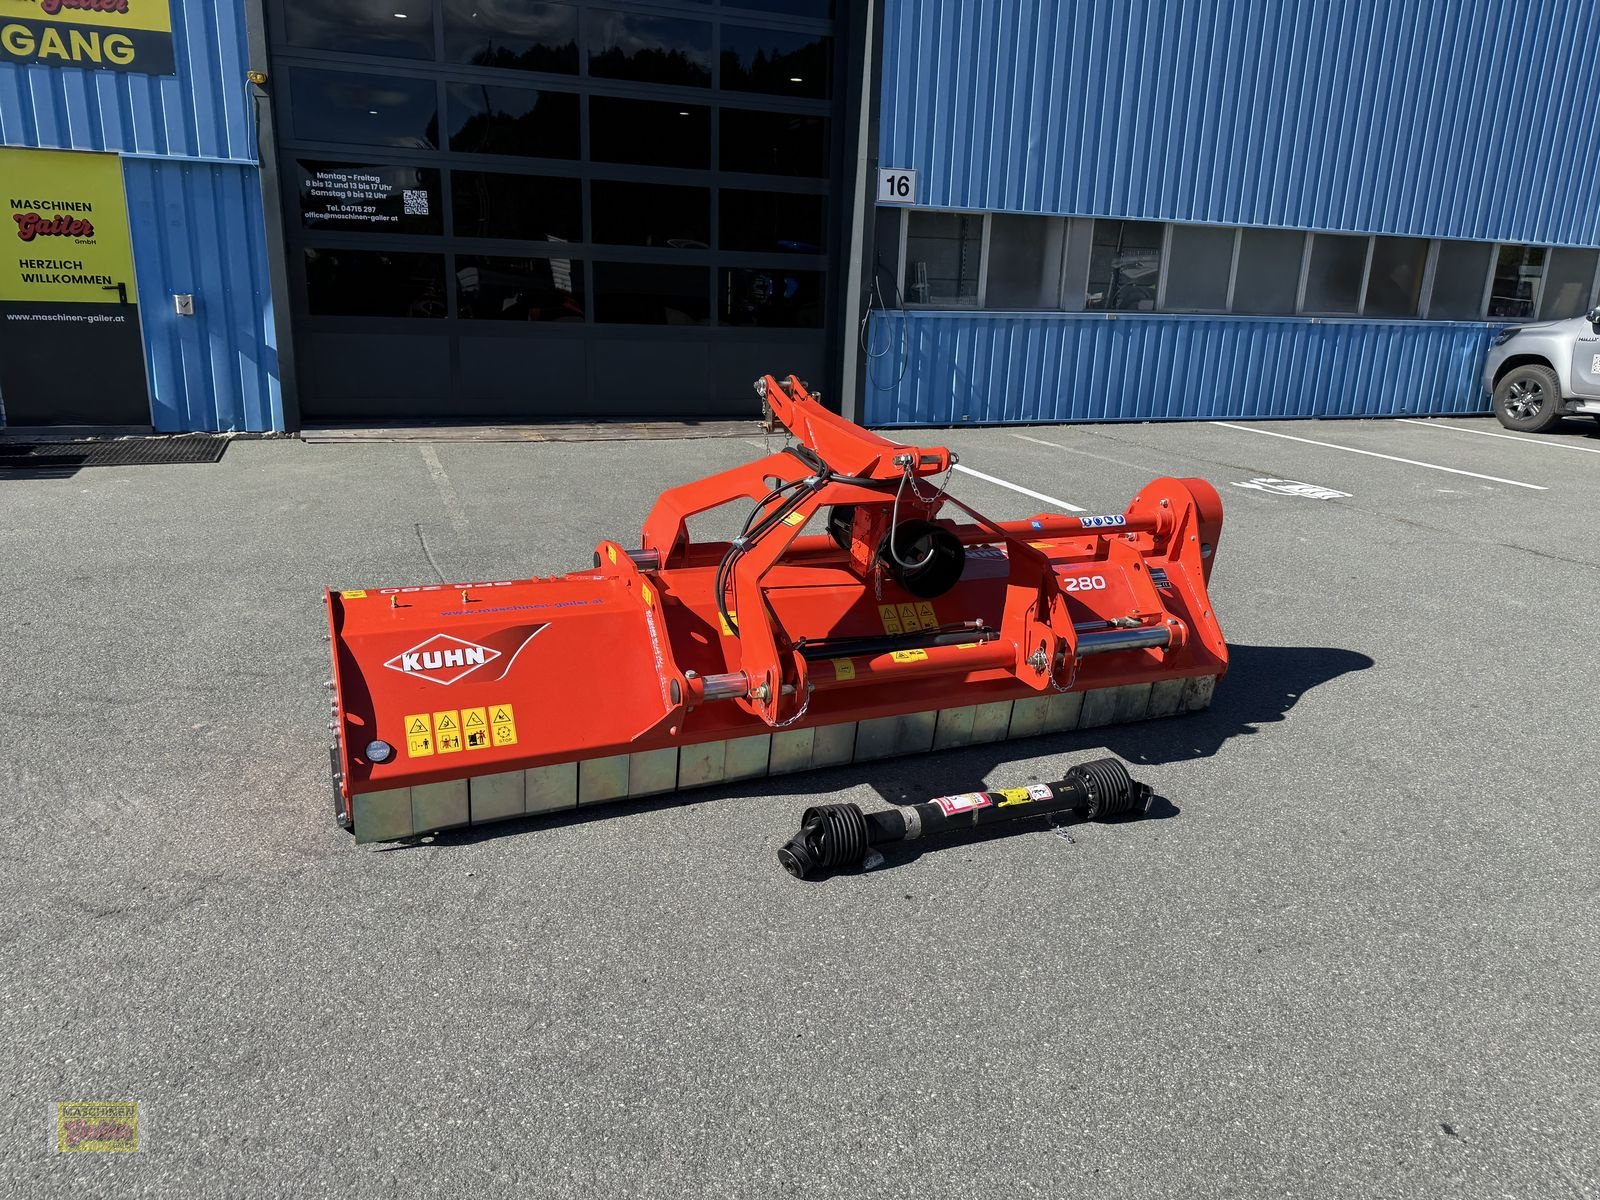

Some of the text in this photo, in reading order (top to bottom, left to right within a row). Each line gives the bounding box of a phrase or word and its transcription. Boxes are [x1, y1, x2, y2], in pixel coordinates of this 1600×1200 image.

[1, 24, 135, 65] GANG
[317, 172, 346, 181] Montag
[354, 174, 380, 183] Freitag
[312, 180, 324, 188] bis
[325, 180, 332, 188] 12
[334, 181, 349, 189] und
[359, 182, 370, 190] bis
[379, 183, 393, 191] Uhr
[886, 175, 910, 197] 16
[311, 189, 346, 198] Samstag
[374, 191, 388, 199] Uhr
[10, 199, 92, 212] MASCHINEN
[326, 204, 376, 213] Tel. 04715 297
[13, 212, 95, 242] Gailer
[19, 259, 82, 270] HERZLICH
[21, 273, 112, 285] WILLKOMMEN
[7, 313, 125, 323] www.maschinen-gailer.at
[1063, 575, 1106, 592] 280
[402, 646, 485, 672] KUHN
